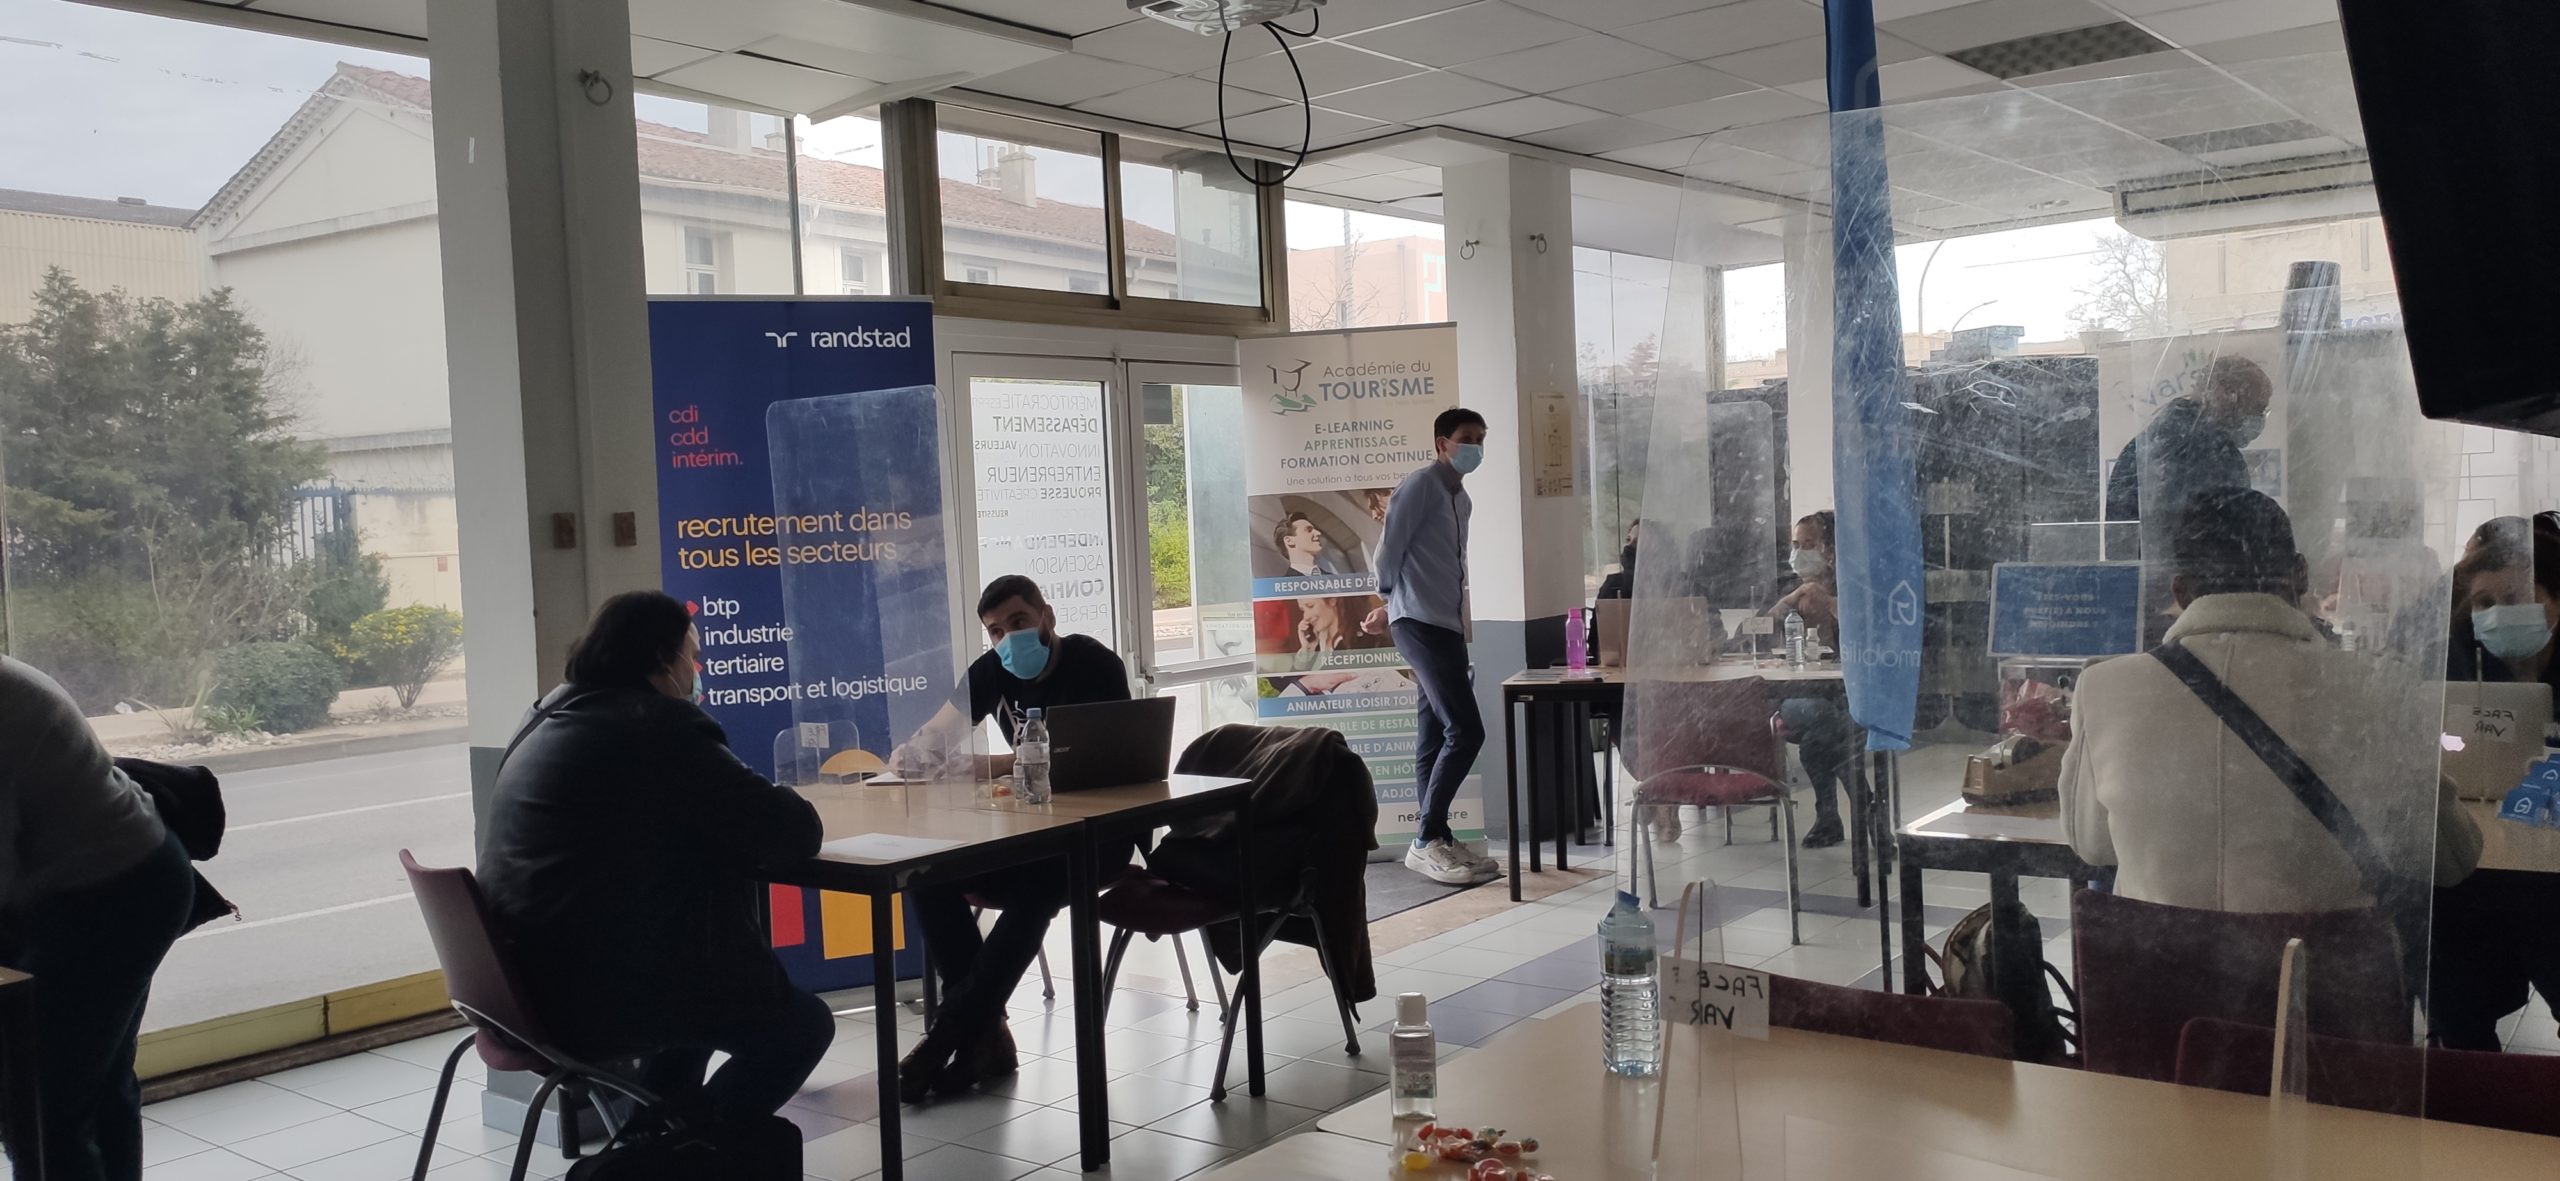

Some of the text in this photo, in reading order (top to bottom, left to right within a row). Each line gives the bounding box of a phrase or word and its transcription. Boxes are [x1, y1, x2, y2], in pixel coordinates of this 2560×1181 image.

[810, 326, 911, 348] randstad
[1323, 360, 1431, 379] Académie du
[669, 404, 699, 424] cdi
[670, 426, 709, 447] cdd
[1315, 419, 1394, 434] E-LEARNING
[1304, 435, 1407, 452] APPRENTISSAGE
[672, 448, 744, 469] intérim.
[1280, 449, 1433, 469] FORMATION CONTINUE
[1286, 478, 1305, 486] Une
[1307, 475, 1342, 485] solution
[1354, 474, 1373, 482] tous
[677, 506, 912, 539] recrutement dans
[678, 538, 897, 569] tous les secteurs
[1274, 578, 1352, 593] RESPONSABLE
[703, 596, 740, 619] btp
[704, 622, 794, 646] industrie
[706, 654, 785, 677] tertiaire
[708, 675, 928, 709] transport et logistique
[1286, 699, 1353, 713] ANIMATEUR
[1356, 697, 1390, 708] LOISIR
[1361, 720, 1375, 731] DE
[1375, 766, 1392, 776] EN
